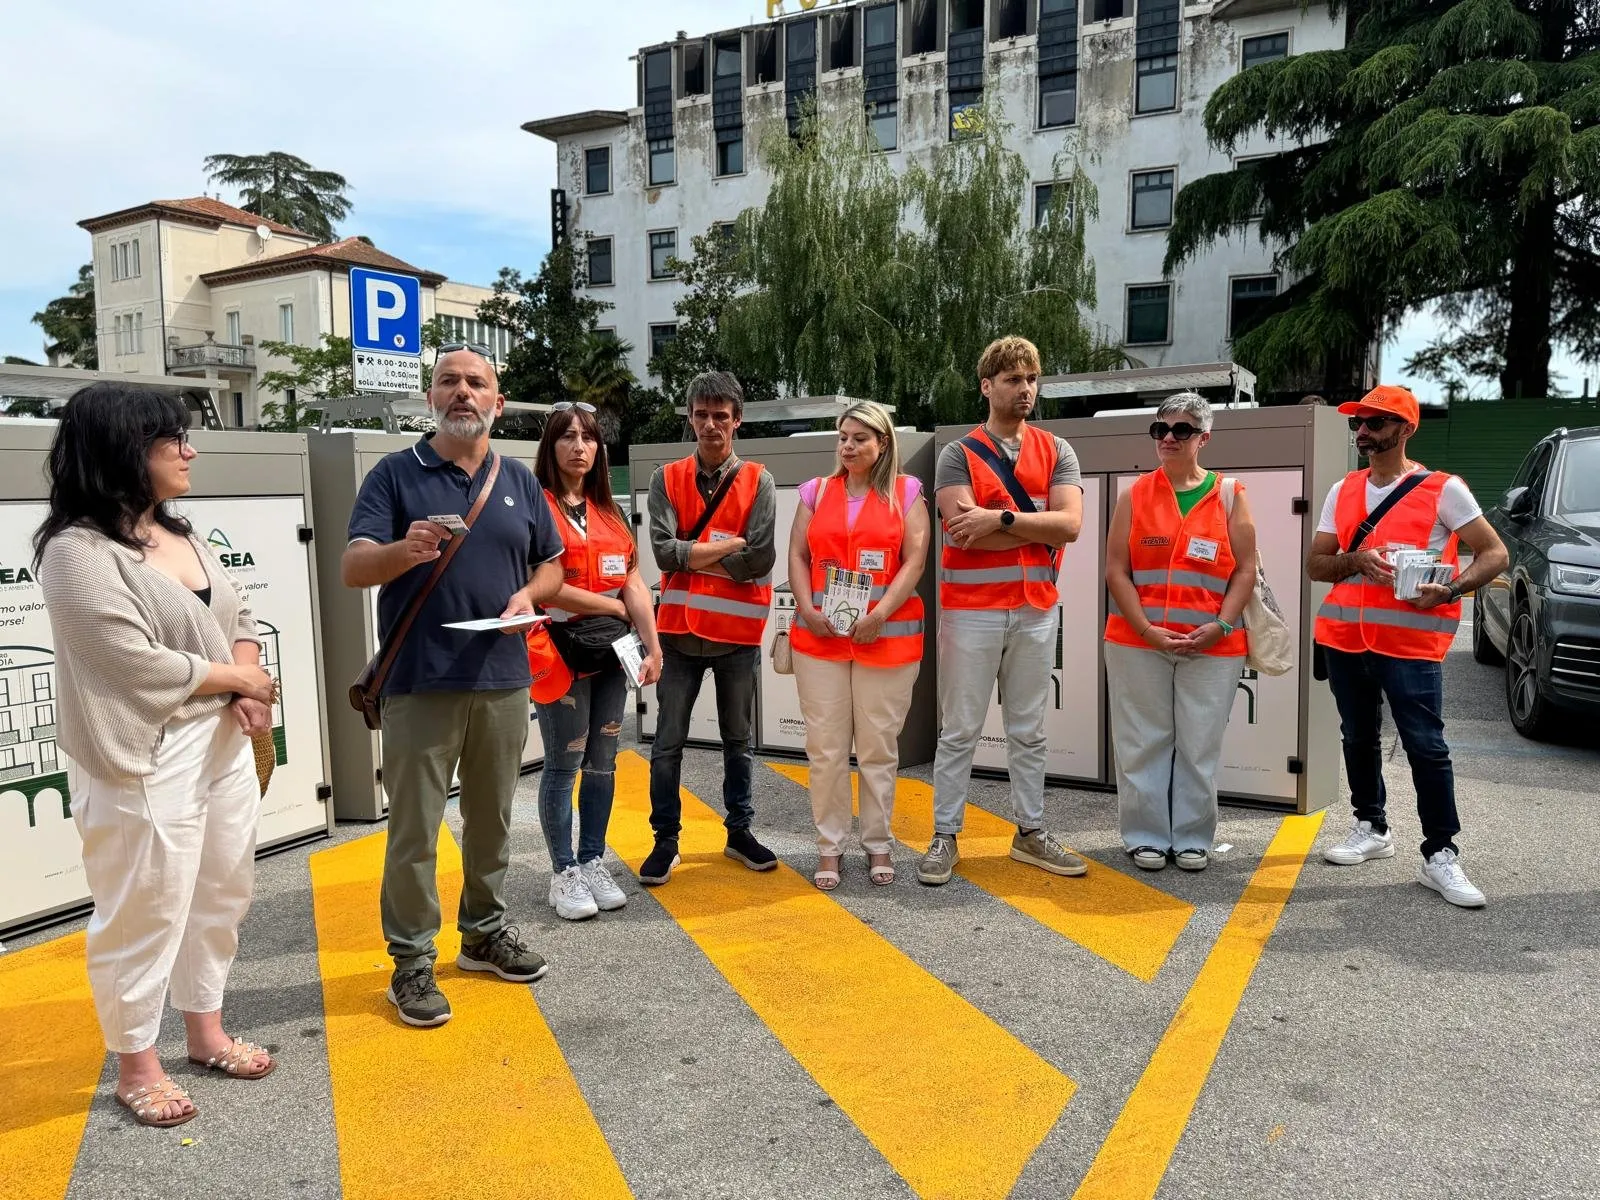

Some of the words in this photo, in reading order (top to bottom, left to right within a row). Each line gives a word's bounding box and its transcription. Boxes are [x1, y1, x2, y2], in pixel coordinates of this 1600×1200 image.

[365, 278, 407, 342] P
[378, 381, 419, 390] autovetture
[219, 552, 255, 568] SEA
[244, 582, 269, 591] valore
[19, 602, 47, 612] valor
